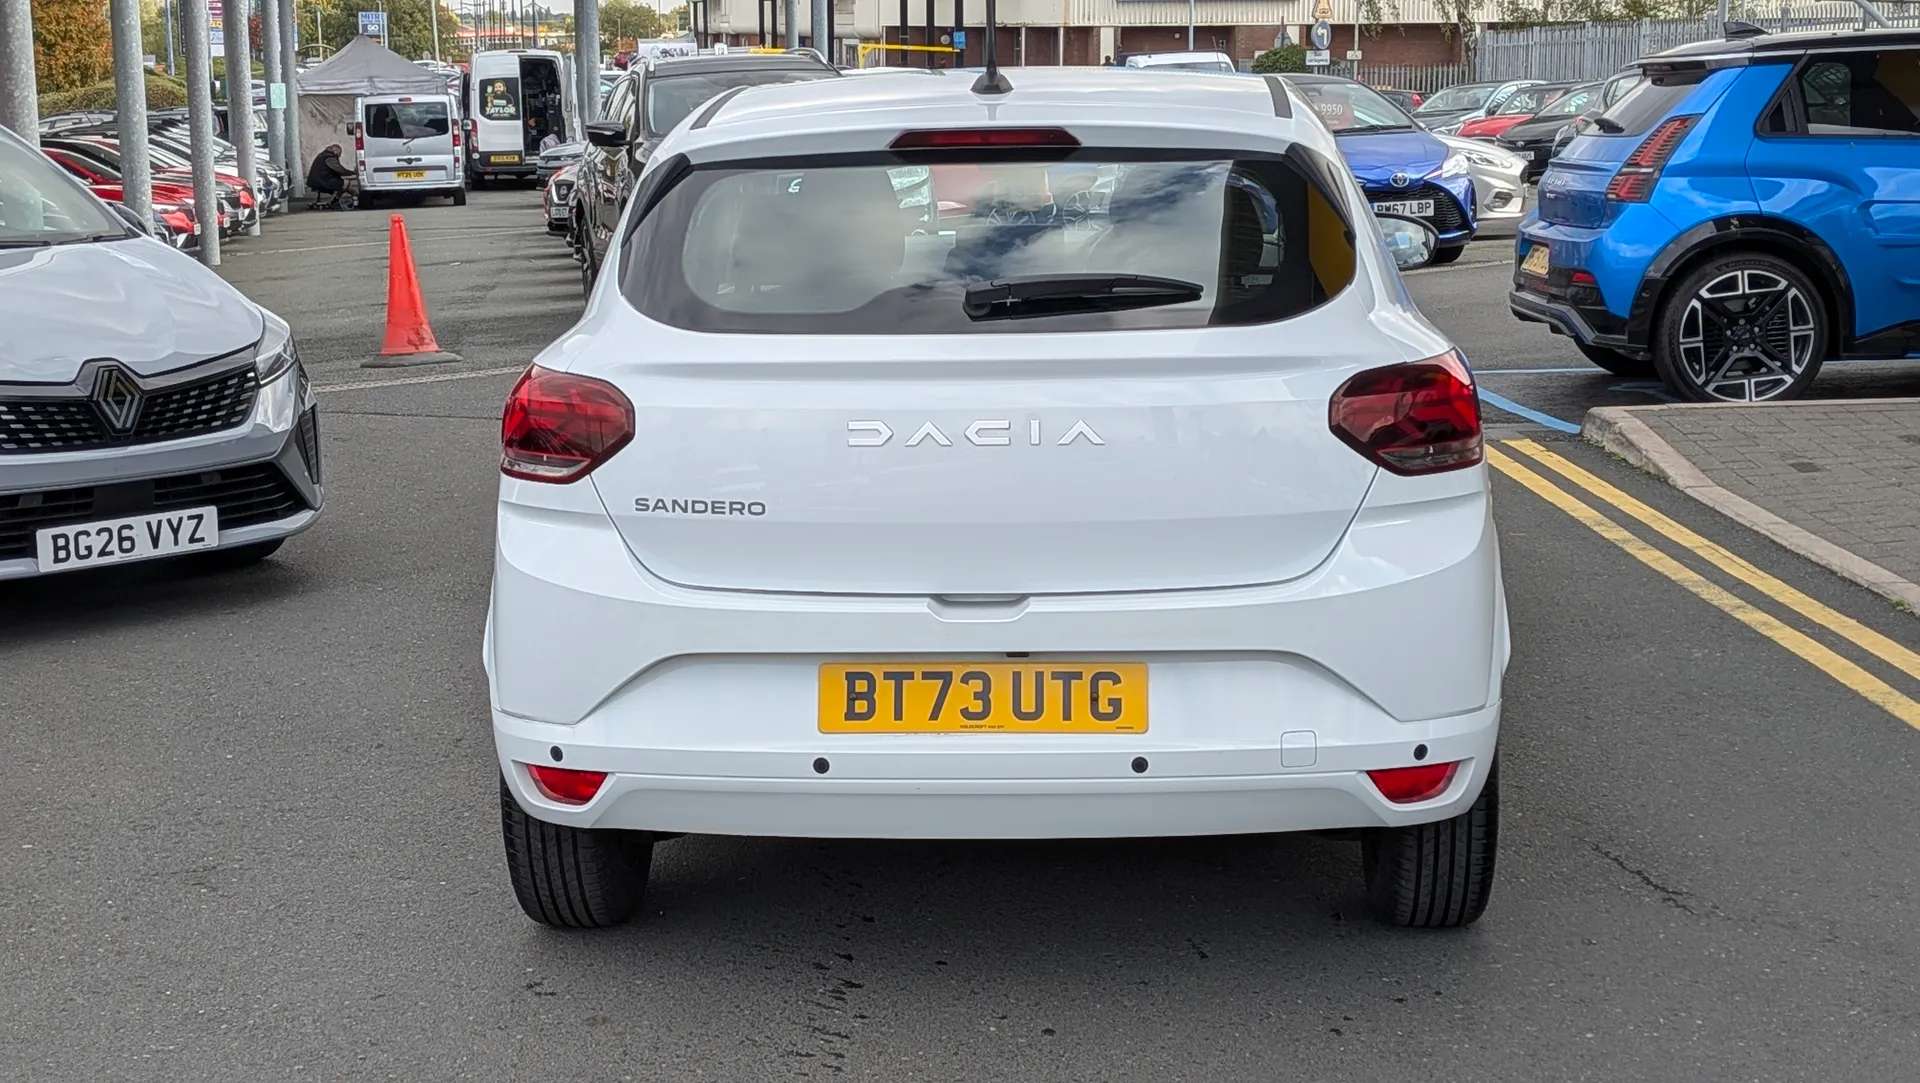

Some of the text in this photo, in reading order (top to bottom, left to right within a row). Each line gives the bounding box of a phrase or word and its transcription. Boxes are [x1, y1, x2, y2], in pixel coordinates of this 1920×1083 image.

[485, 106, 516, 114] TAYLOR
[1409, 202, 1431, 215] LBP
[847, 419, 1106, 447] DACIA
[634, 497, 766, 516] SANDERO
[51, 513, 205, 564] BG26 VYZ
[844, 670, 1123, 722] BT73 UTG
